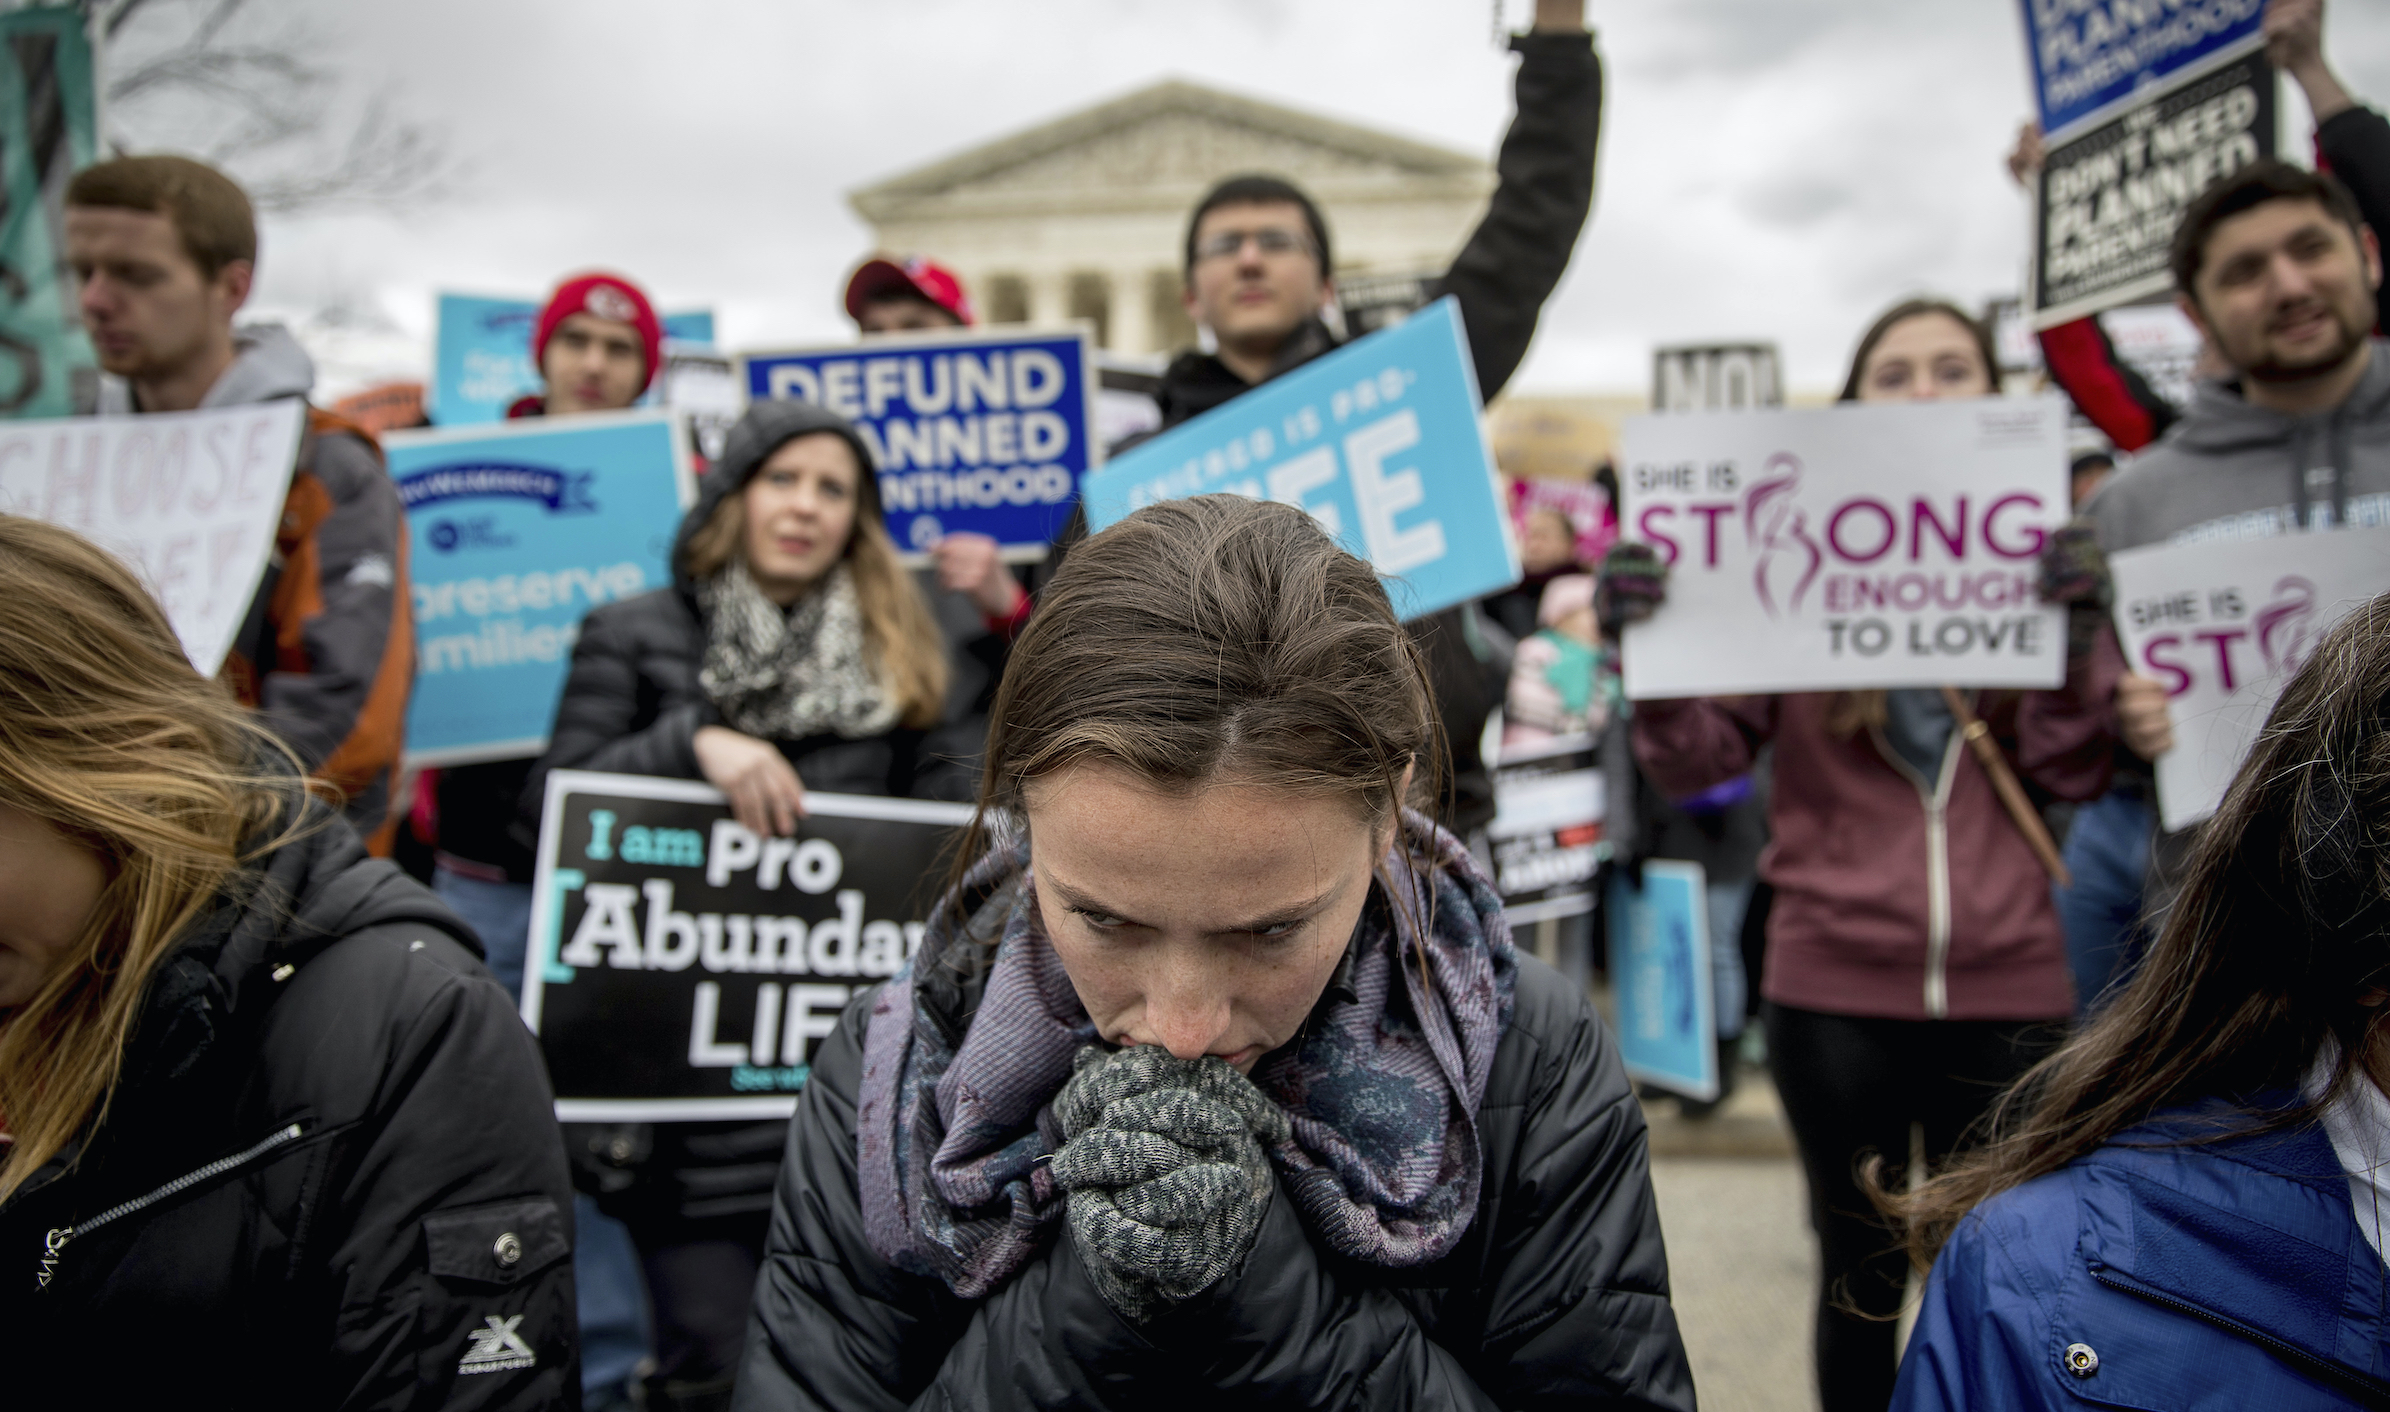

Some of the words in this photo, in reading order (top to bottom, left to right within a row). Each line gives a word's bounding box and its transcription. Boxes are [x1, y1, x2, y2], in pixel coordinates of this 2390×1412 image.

[767, 350, 1067, 419] DEFUND
[879, 464, 1075, 513] NTHOOD
[1634, 464, 1695, 491] SHE
[1706, 461, 1740, 490] IS
[1826, 617, 1891, 657] TO
[1911, 616, 2044, 658] LOVE
[2129, 595, 2198, 630] SHE
[2208, 587, 2247, 618] IS
[586, 809, 618, 861] I
[619, 824, 705, 868] am
[706, 817, 844, 895] Pro
[561, 877, 925, 978] Abunda
[687, 980, 862, 1069] LIF
